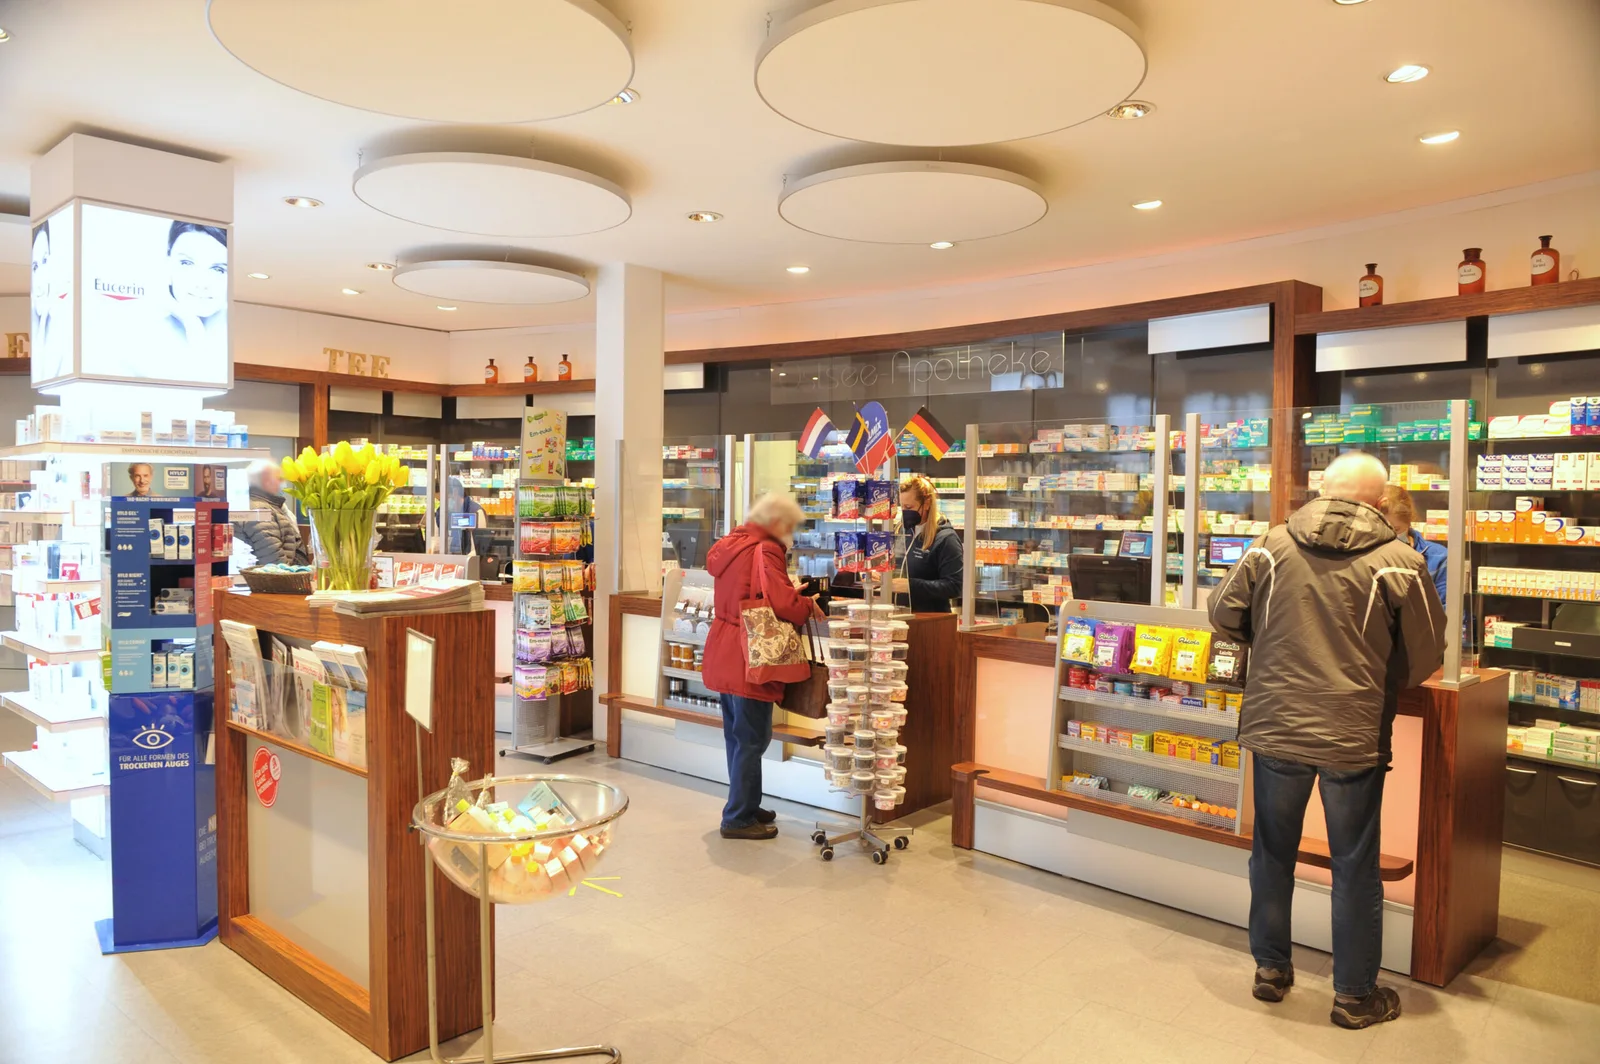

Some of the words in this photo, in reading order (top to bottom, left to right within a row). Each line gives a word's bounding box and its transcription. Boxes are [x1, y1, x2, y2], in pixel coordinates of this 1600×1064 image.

[94, 277, 146, 296] Eucerin
[323, 347, 391, 379] TEE
[529, 426, 553, 438] Em-eukal
[1098, 633, 1119, 641] Ricola
[1140, 633, 1163, 642] Ricola
[1178, 636, 1200, 645] Ricola
[1213, 640, 1240, 651] Ricola
[1182, 698, 1203, 707] wybert
[133, 754, 148, 762] ALLE
[149, 753, 176, 761] FORMEN
[177, 752, 190, 760] DES
[119, 761, 164, 770] TROCKENEN
[164, 760, 190, 768] AUGES
